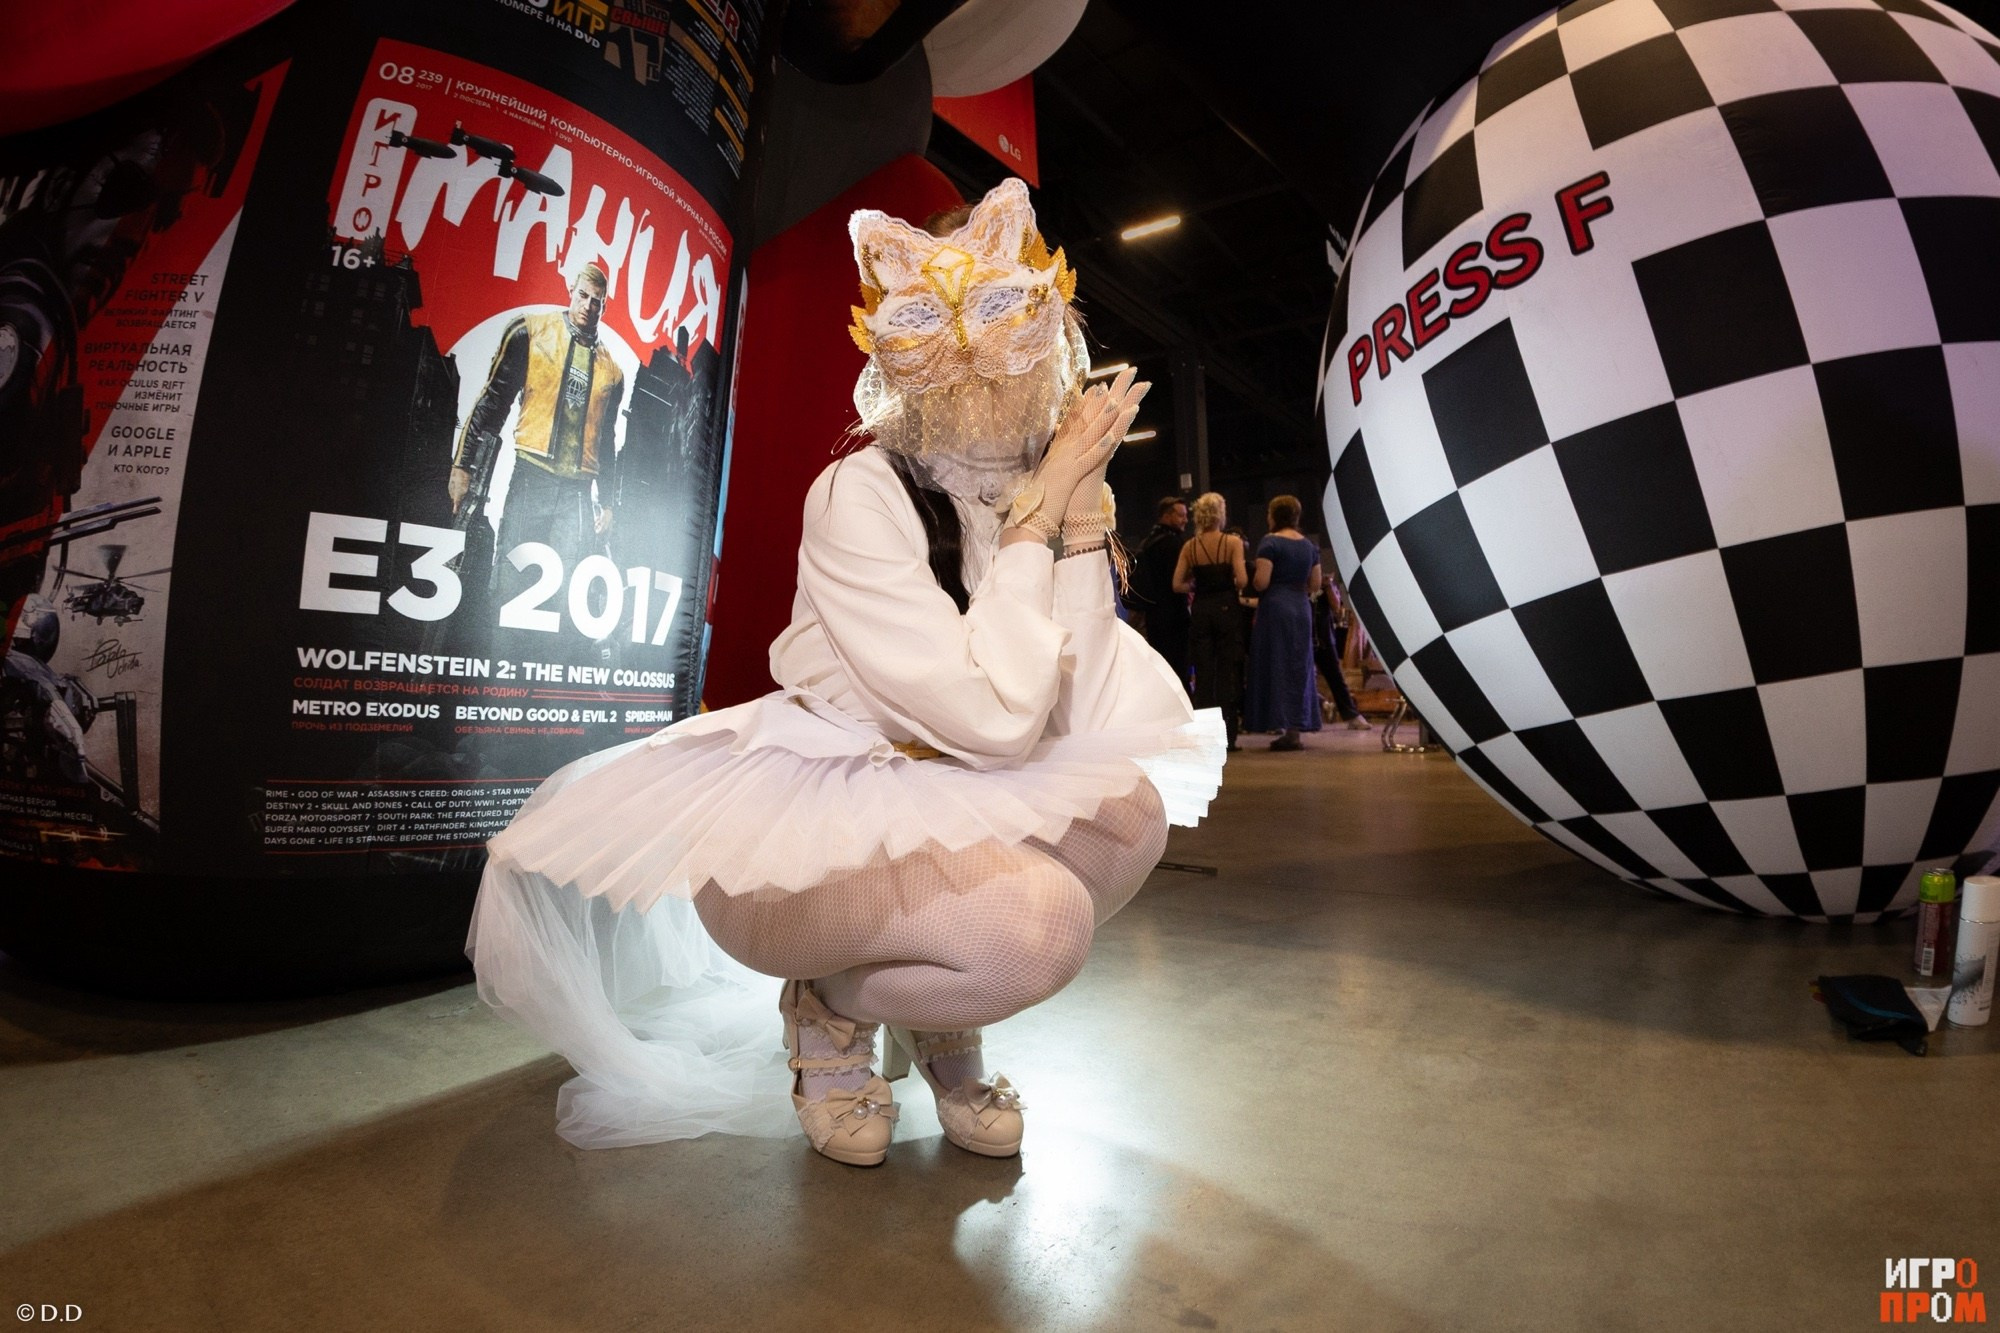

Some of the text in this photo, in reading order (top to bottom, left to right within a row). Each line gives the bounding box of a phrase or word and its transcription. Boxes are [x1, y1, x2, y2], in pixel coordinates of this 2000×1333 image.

[496, 0, 543, 20] ОМЕРЕ
[545, 14, 555, 25] И
[557, 20, 573, 34] НА
[574, 29, 601, 49] DVD
[552, 0, 605, 35] ИГР
[378, 62, 416, 85] 08
[418, 69, 444, 84] 239
[415, 81, 434, 91] 2017
[459, 94, 492, 109] ПОСТЕРА
[559, 133, 573, 143] DVD
[456, 80, 548, 122] КРУПНЕЙШИЙ
[550, 115, 676, 199] КОМПЬЮТЕРНО-ИГРОВОЙ
[676, 195, 704, 227] ЖУРНАЛ
[704, 222, 709, 231] В
[1010, 143, 1022, 162] LG
[353, 109, 402, 233] ИГРО
[395, 143, 721, 355] МАНИЯ
[331, 245, 376, 270] 16+
[151, 272, 208, 286] STREET
[126, 289, 204, 303] FIGHTER V
[1347, 171, 1614, 407] PRESS F
[151, 308, 200, 319] ФАЙТИНГ
[84, 342, 192, 357] ВИРТУАЛЬНАЯ
[89, 360, 188, 374] РЕАЛЬНОСТЬ
[121, 379, 159, 389] OCULUS
[162, 380, 185, 390] RIFT
[96, 401, 180, 413] ГОНОЧНЫЕ ИГРЫ
[111, 425, 176, 441] GOOGLE
[108, 444, 173, 459] И APPLE
[113, 464, 170, 475] КТО КОГО?
[299, 511, 683, 646] E3 2017
[296, 647, 675, 689] WOLFENSTEIN 2: THE NEW COLOSSUS
[293, 677, 529, 698] СОЛДАТ ВОЗВРАЩАЕТСЯ НА РОДИНУ
[292, 699, 440, 719] METRO EXODUS
[455, 705, 617, 723] BEYOND GOOD & EVIL 2
[624, 710, 673, 723] SPIDER-MAN
[291, 721, 327, 731] ПРОЧЬ
[345, 722, 414, 733] ПОДЗЕМЕЛИЙ
[454, 725, 501, 735] ОБЕЗЬЯНА
[265, 790, 289, 798] RIME
[297, 790, 319, 799] GOD
[321, 791, 335, 799] OF
[367, 790, 416, 798] ASSASSIN'S
[418, 789, 449, 798] CREED:
[451, 788, 485, 797] ORIGINS
[492, 788, 511, 796] STAR
[513, 787, 535, 795] WARS
[265, 802, 305, 810] DESTINY
[306, 802, 313, 810] 2
[321, 802, 350, 811] SKULL
[352, 801, 372, 809] AND
[410, 801, 433, 809] CALL
[434, 801, 447, 809] OF
[448, 800, 472, 808] DUTY:
[474, 799, 495, 807] WWII
[265, 813, 298, 822] FORZA
[299, 813, 363, 822] MOTORSPORT
[377, 812, 408, 820] SOUTH
[410, 812, 435, 820] PARK:
[437, 811, 453, 819] THE
[455, 809, 502, 819] FRACTURED
[503, 808, 519, 817] BUT
[265, 826, 294, 834] SUPER
[329, 824, 370, 833] ODYSSEY
[377, 823, 398, 832] DIRT
[399, 823, 406, 831] 4
[413, 822, 467, 831] PATHFINDER:
[469, 819, 509, 828] KINGMAKE
[264, 837, 287, 845] DAYS
[289, 837, 316, 845] GONE
[324, 836, 344, 844] LIFE
[345, 836, 354, 844] IS
[399, 833, 433, 842] BEFORE
[435, 833, 451, 841] THE
[453, 831, 480, 840] STORM
